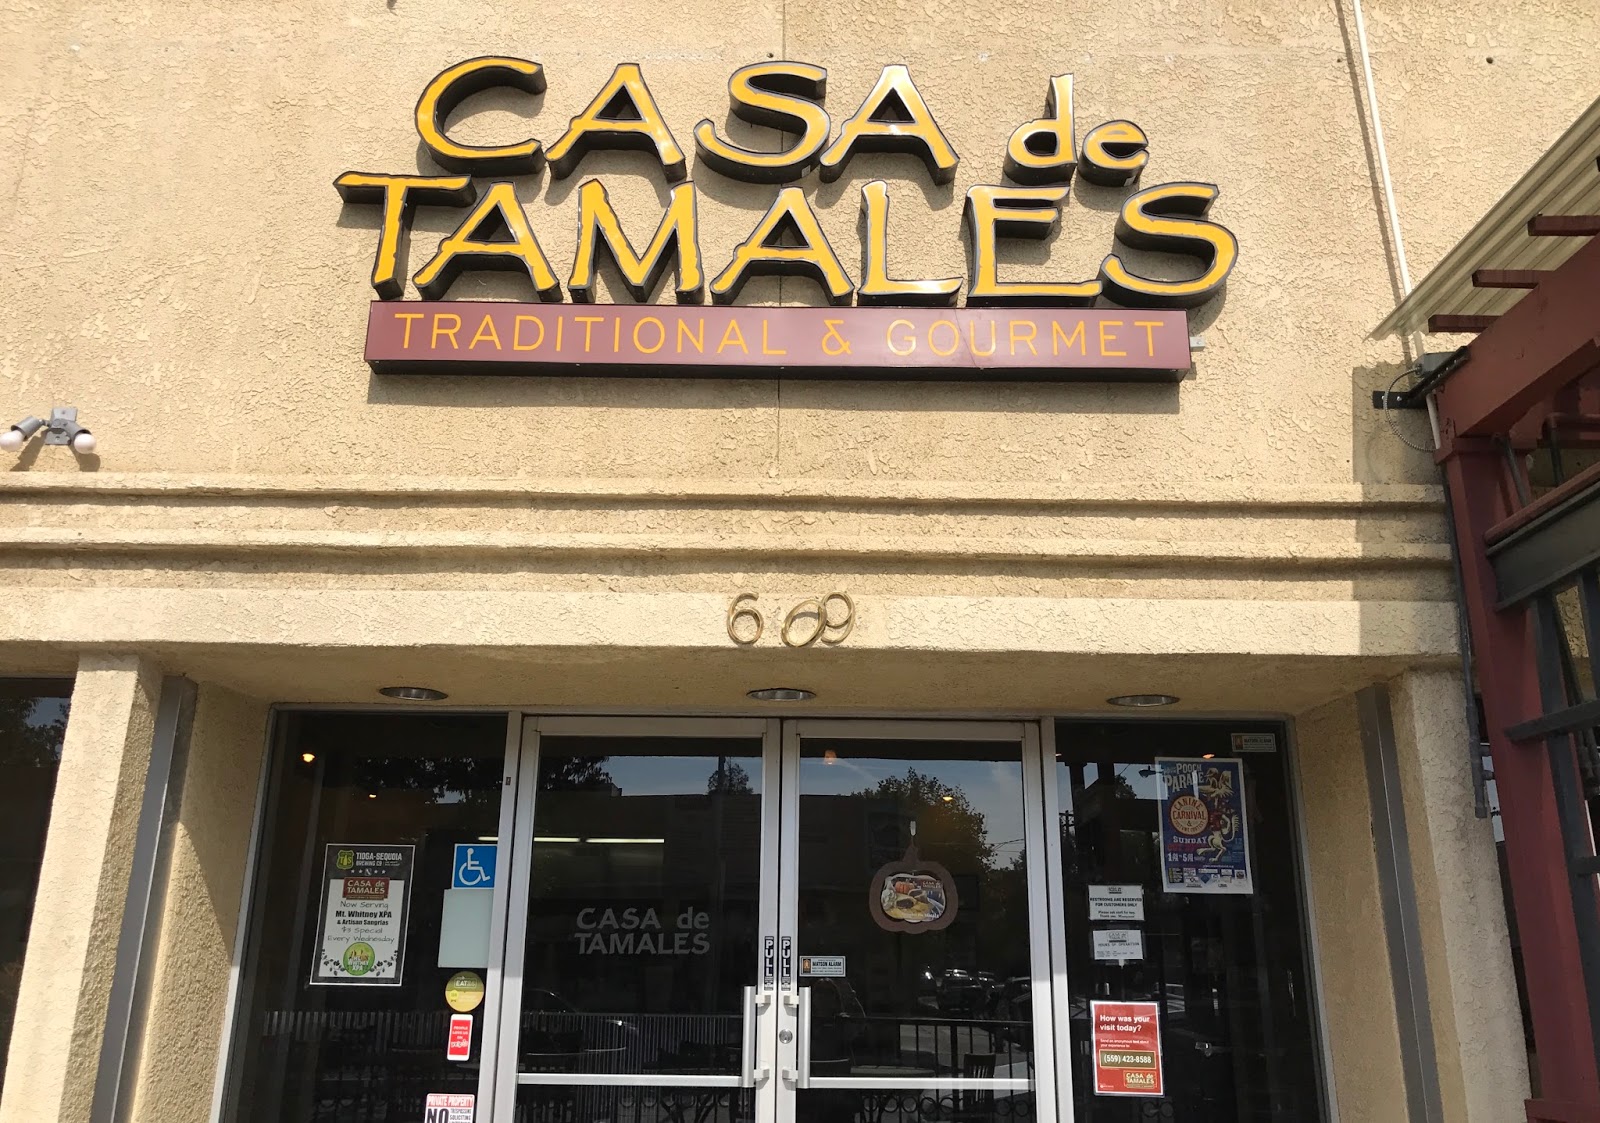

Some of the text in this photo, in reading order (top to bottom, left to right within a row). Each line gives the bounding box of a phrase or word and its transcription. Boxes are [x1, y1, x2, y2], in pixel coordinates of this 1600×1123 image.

[414, 55, 1150, 187] CASA de
[333, 171, 1238, 307] TAMALES
[394, 313, 1164, 357] TRADITIONAL & GOURMET
[1176, 763, 1202, 774] POOCH
[1173, 797, 1203, 811] CANINE
[1172, 810, 1207, 820] CARNIVAL
[1173, 835, 1208, 844] SUNDAY
[356, 852, 402, 861] TIOGA-SEQUOIA
[340, 900, 389, 911] Now Serving
[335, 910, 392, 919] Mt. Whitney XPA
[576, 906, 710, 930] CASA de
[354, 927, 383, 935] Special
[327, 934, 395, 944] Every Wednesday
[574, 932, 711, 955] TAMALES
[765, 940, 774, 977] PULL
[782, 940, 791, 977] PULL
[1100, 1014, 1117, 1022] How
[1134, 1016, 1150, 1024] your
[1100, 1023, 1142, 1033] visit today?
[1103, 1054, 1152, 1064] (559) 423-8588
[428, 1095, 473, 1107] PRIVATE PROPERTY
[427, 1108, 449, 1123] NO
